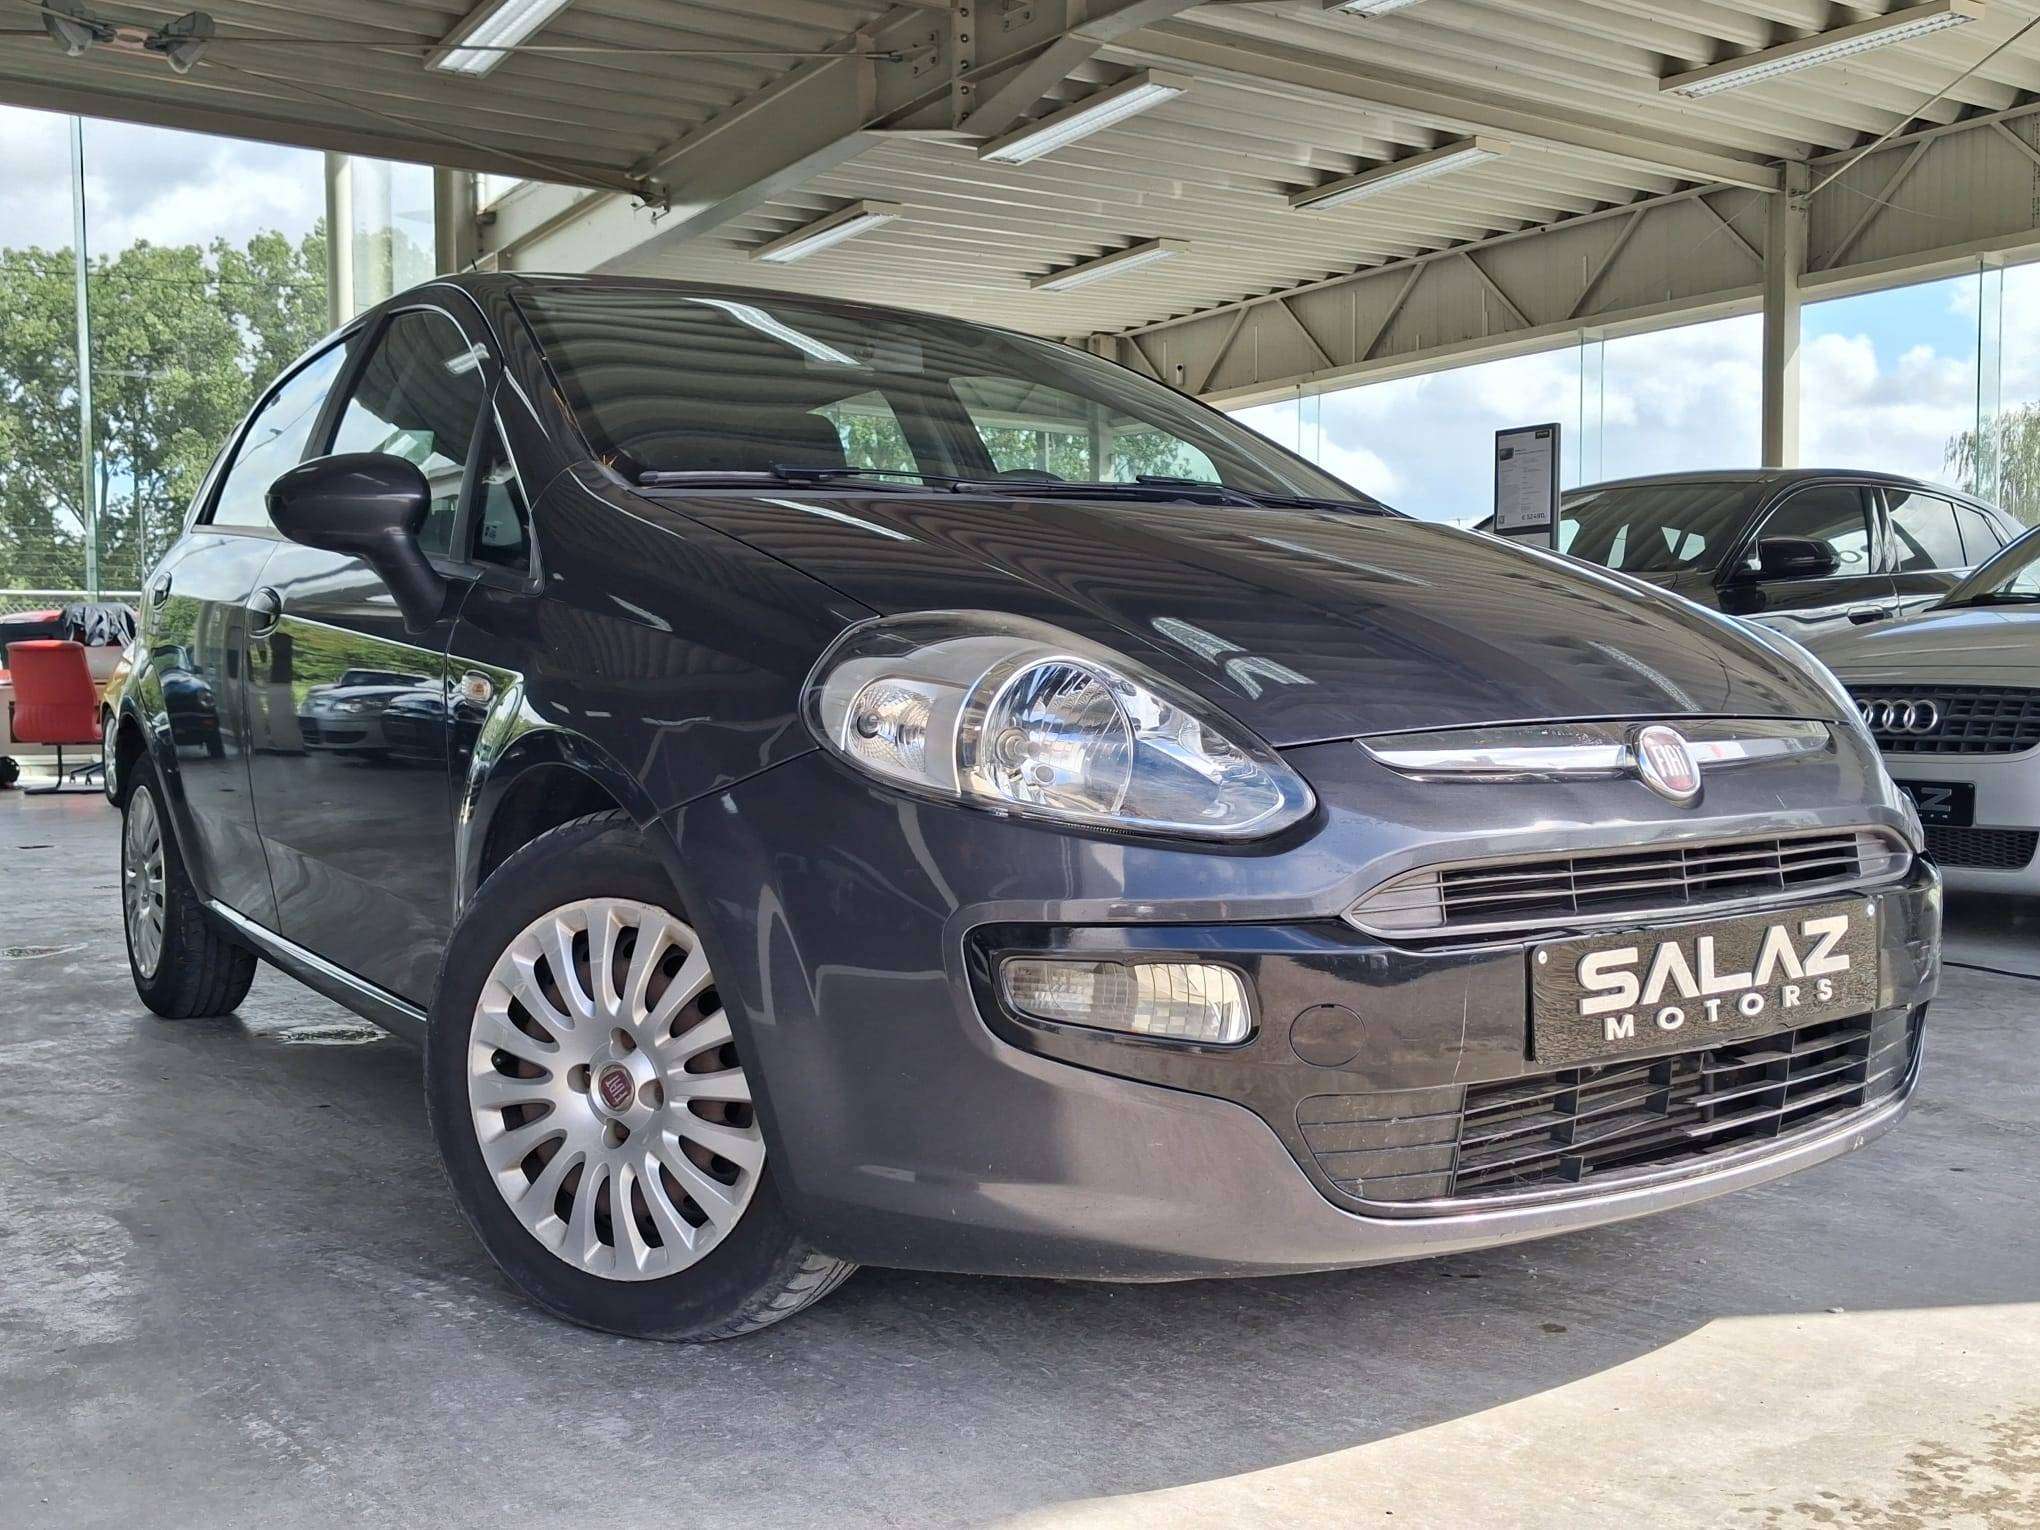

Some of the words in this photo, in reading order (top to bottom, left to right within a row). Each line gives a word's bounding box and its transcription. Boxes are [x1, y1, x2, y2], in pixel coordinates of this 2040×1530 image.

[1650, 743, 1690, 778] FIAT
[1579, 914, 1850, 1015] SALAZ
[1604, 978, 1834, 1041] MOTORS
